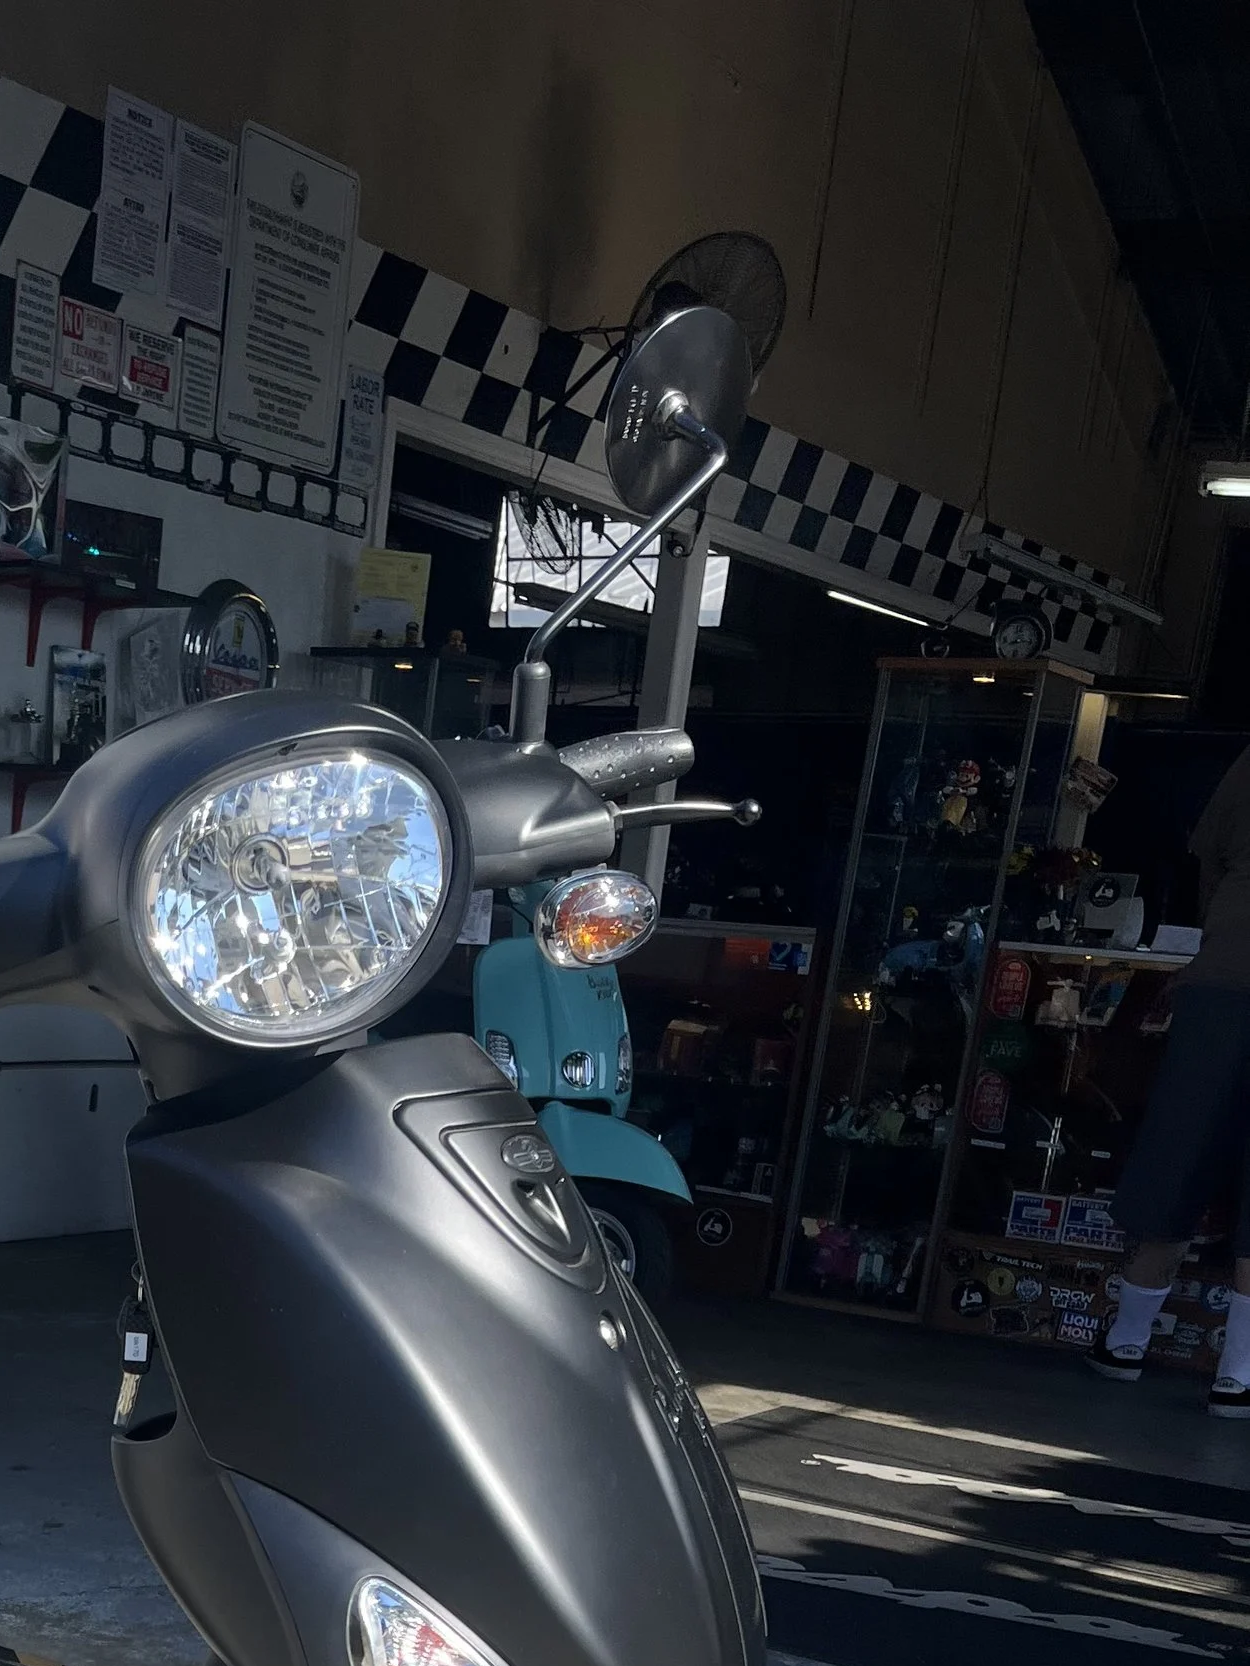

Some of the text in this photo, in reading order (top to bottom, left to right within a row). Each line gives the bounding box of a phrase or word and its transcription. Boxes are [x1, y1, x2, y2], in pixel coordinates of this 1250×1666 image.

[63, 303, 83, 336] NO
[350, 375, 380, 399] LABOR
[353, 394, 375, 416] RATE
[1020, 1260, 1043, 1271] TECH
[1063, 1311, 1099, 1330] LIQUI
[1060, 1324, 1094, 1341] MOLY
